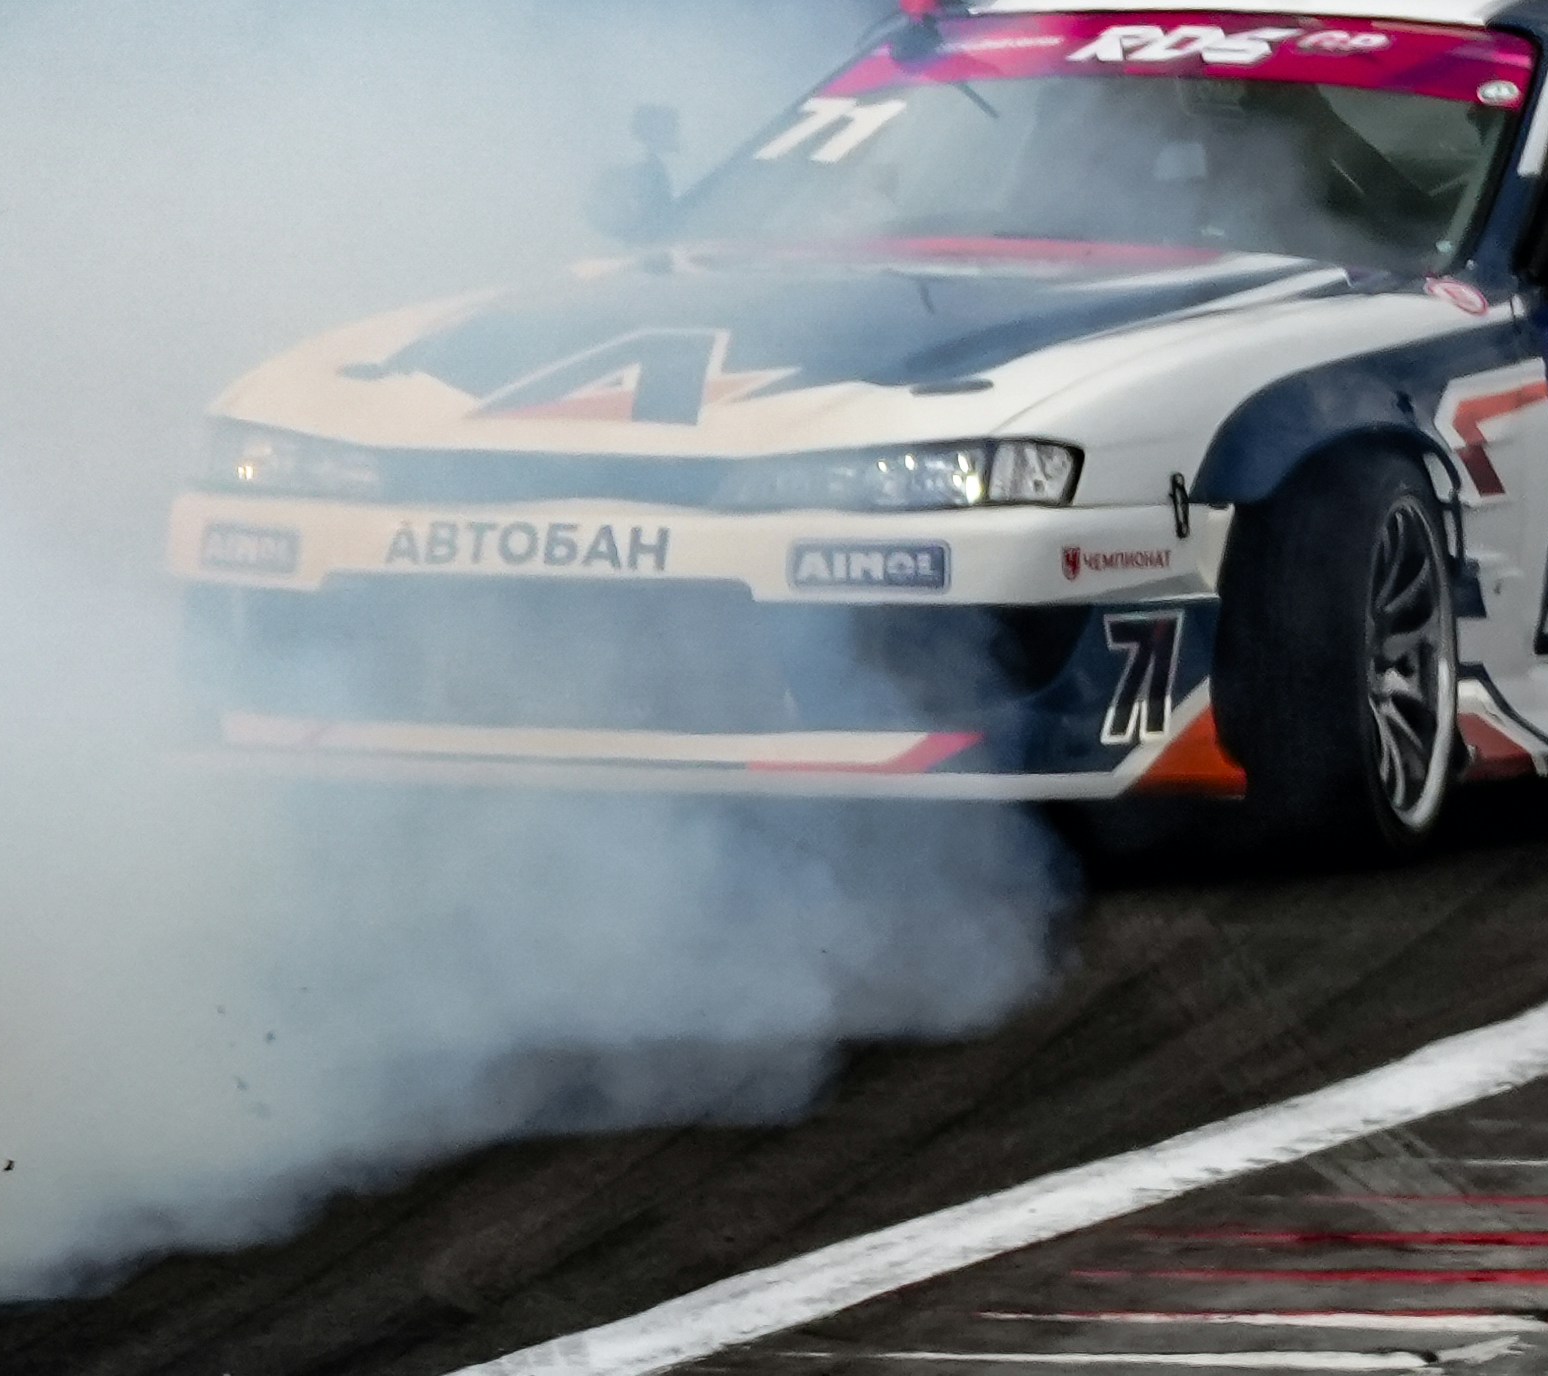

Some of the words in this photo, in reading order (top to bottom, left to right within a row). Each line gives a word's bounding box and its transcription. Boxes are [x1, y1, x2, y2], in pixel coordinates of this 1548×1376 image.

[1067, 25, 1302, 65] RDS
[385, 520, 671, 572] АВТОБАН
[798, 549, 935, 582] AIMOL
